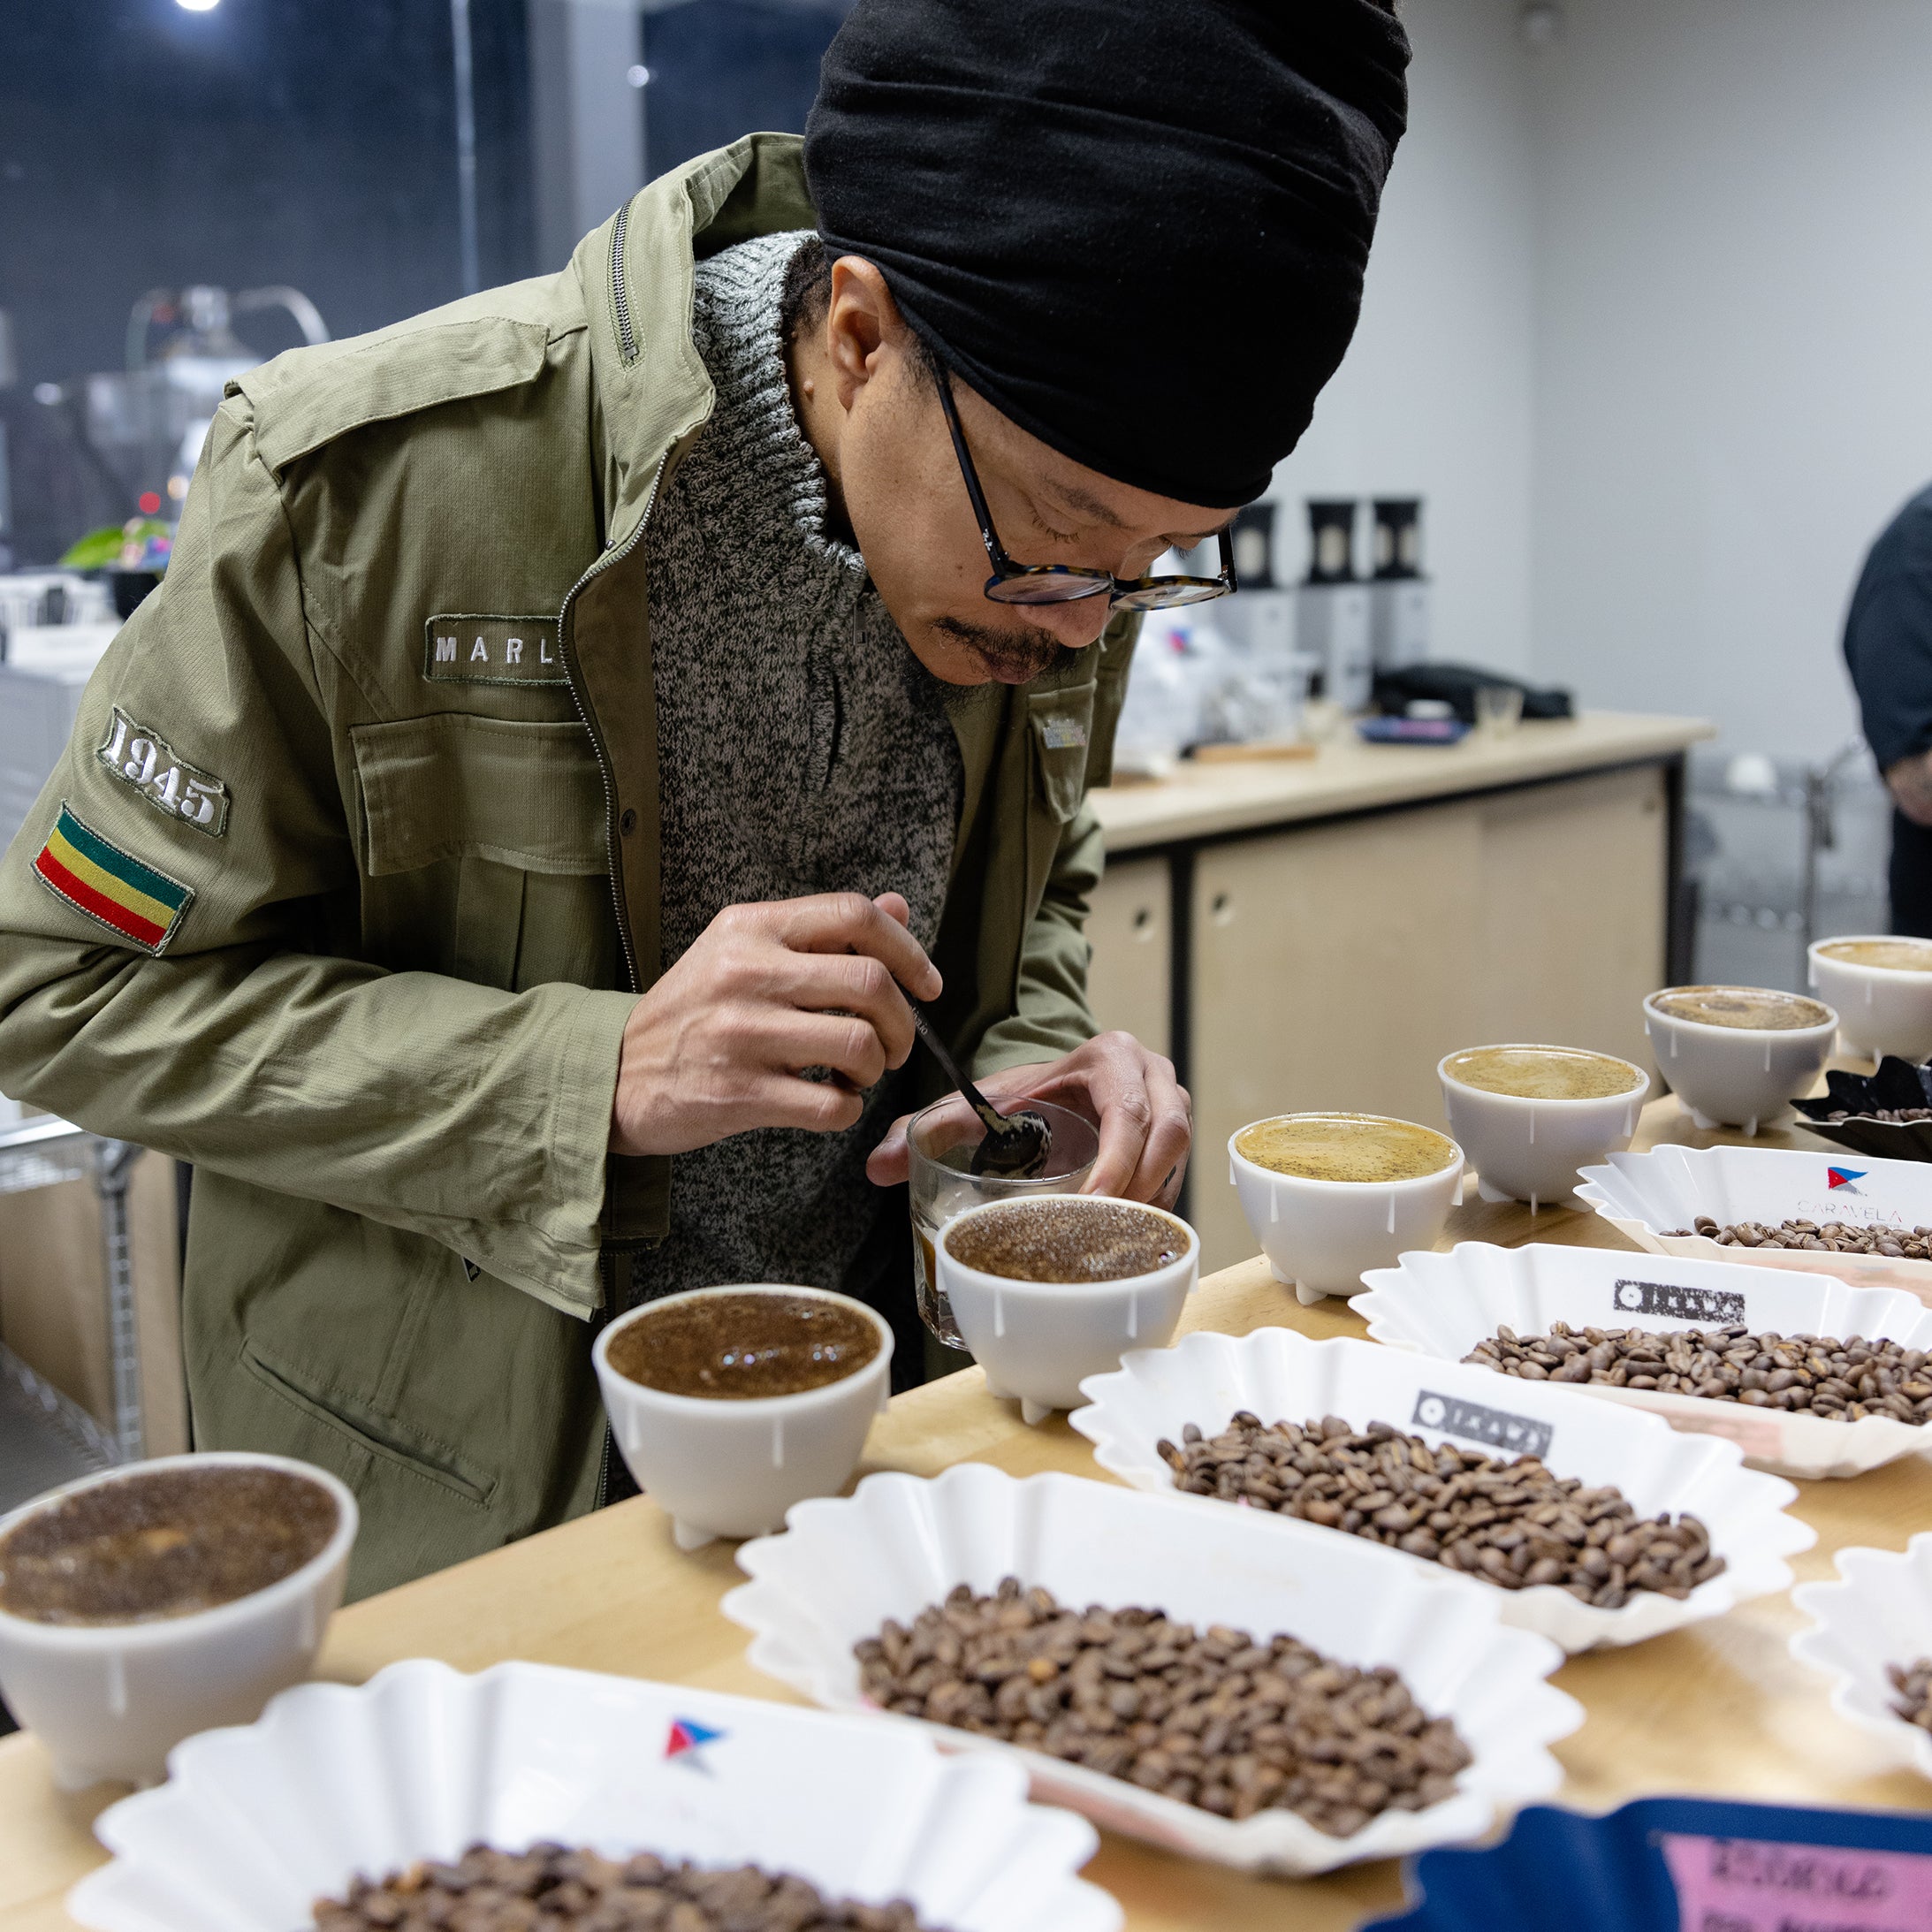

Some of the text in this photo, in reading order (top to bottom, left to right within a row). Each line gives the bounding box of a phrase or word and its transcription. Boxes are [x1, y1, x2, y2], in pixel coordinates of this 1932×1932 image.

[436, 635, 553, 664] MARL
[103, 717, 221, 824] 1945
[1797, 1200, 1903, 1223] CARAVELA
